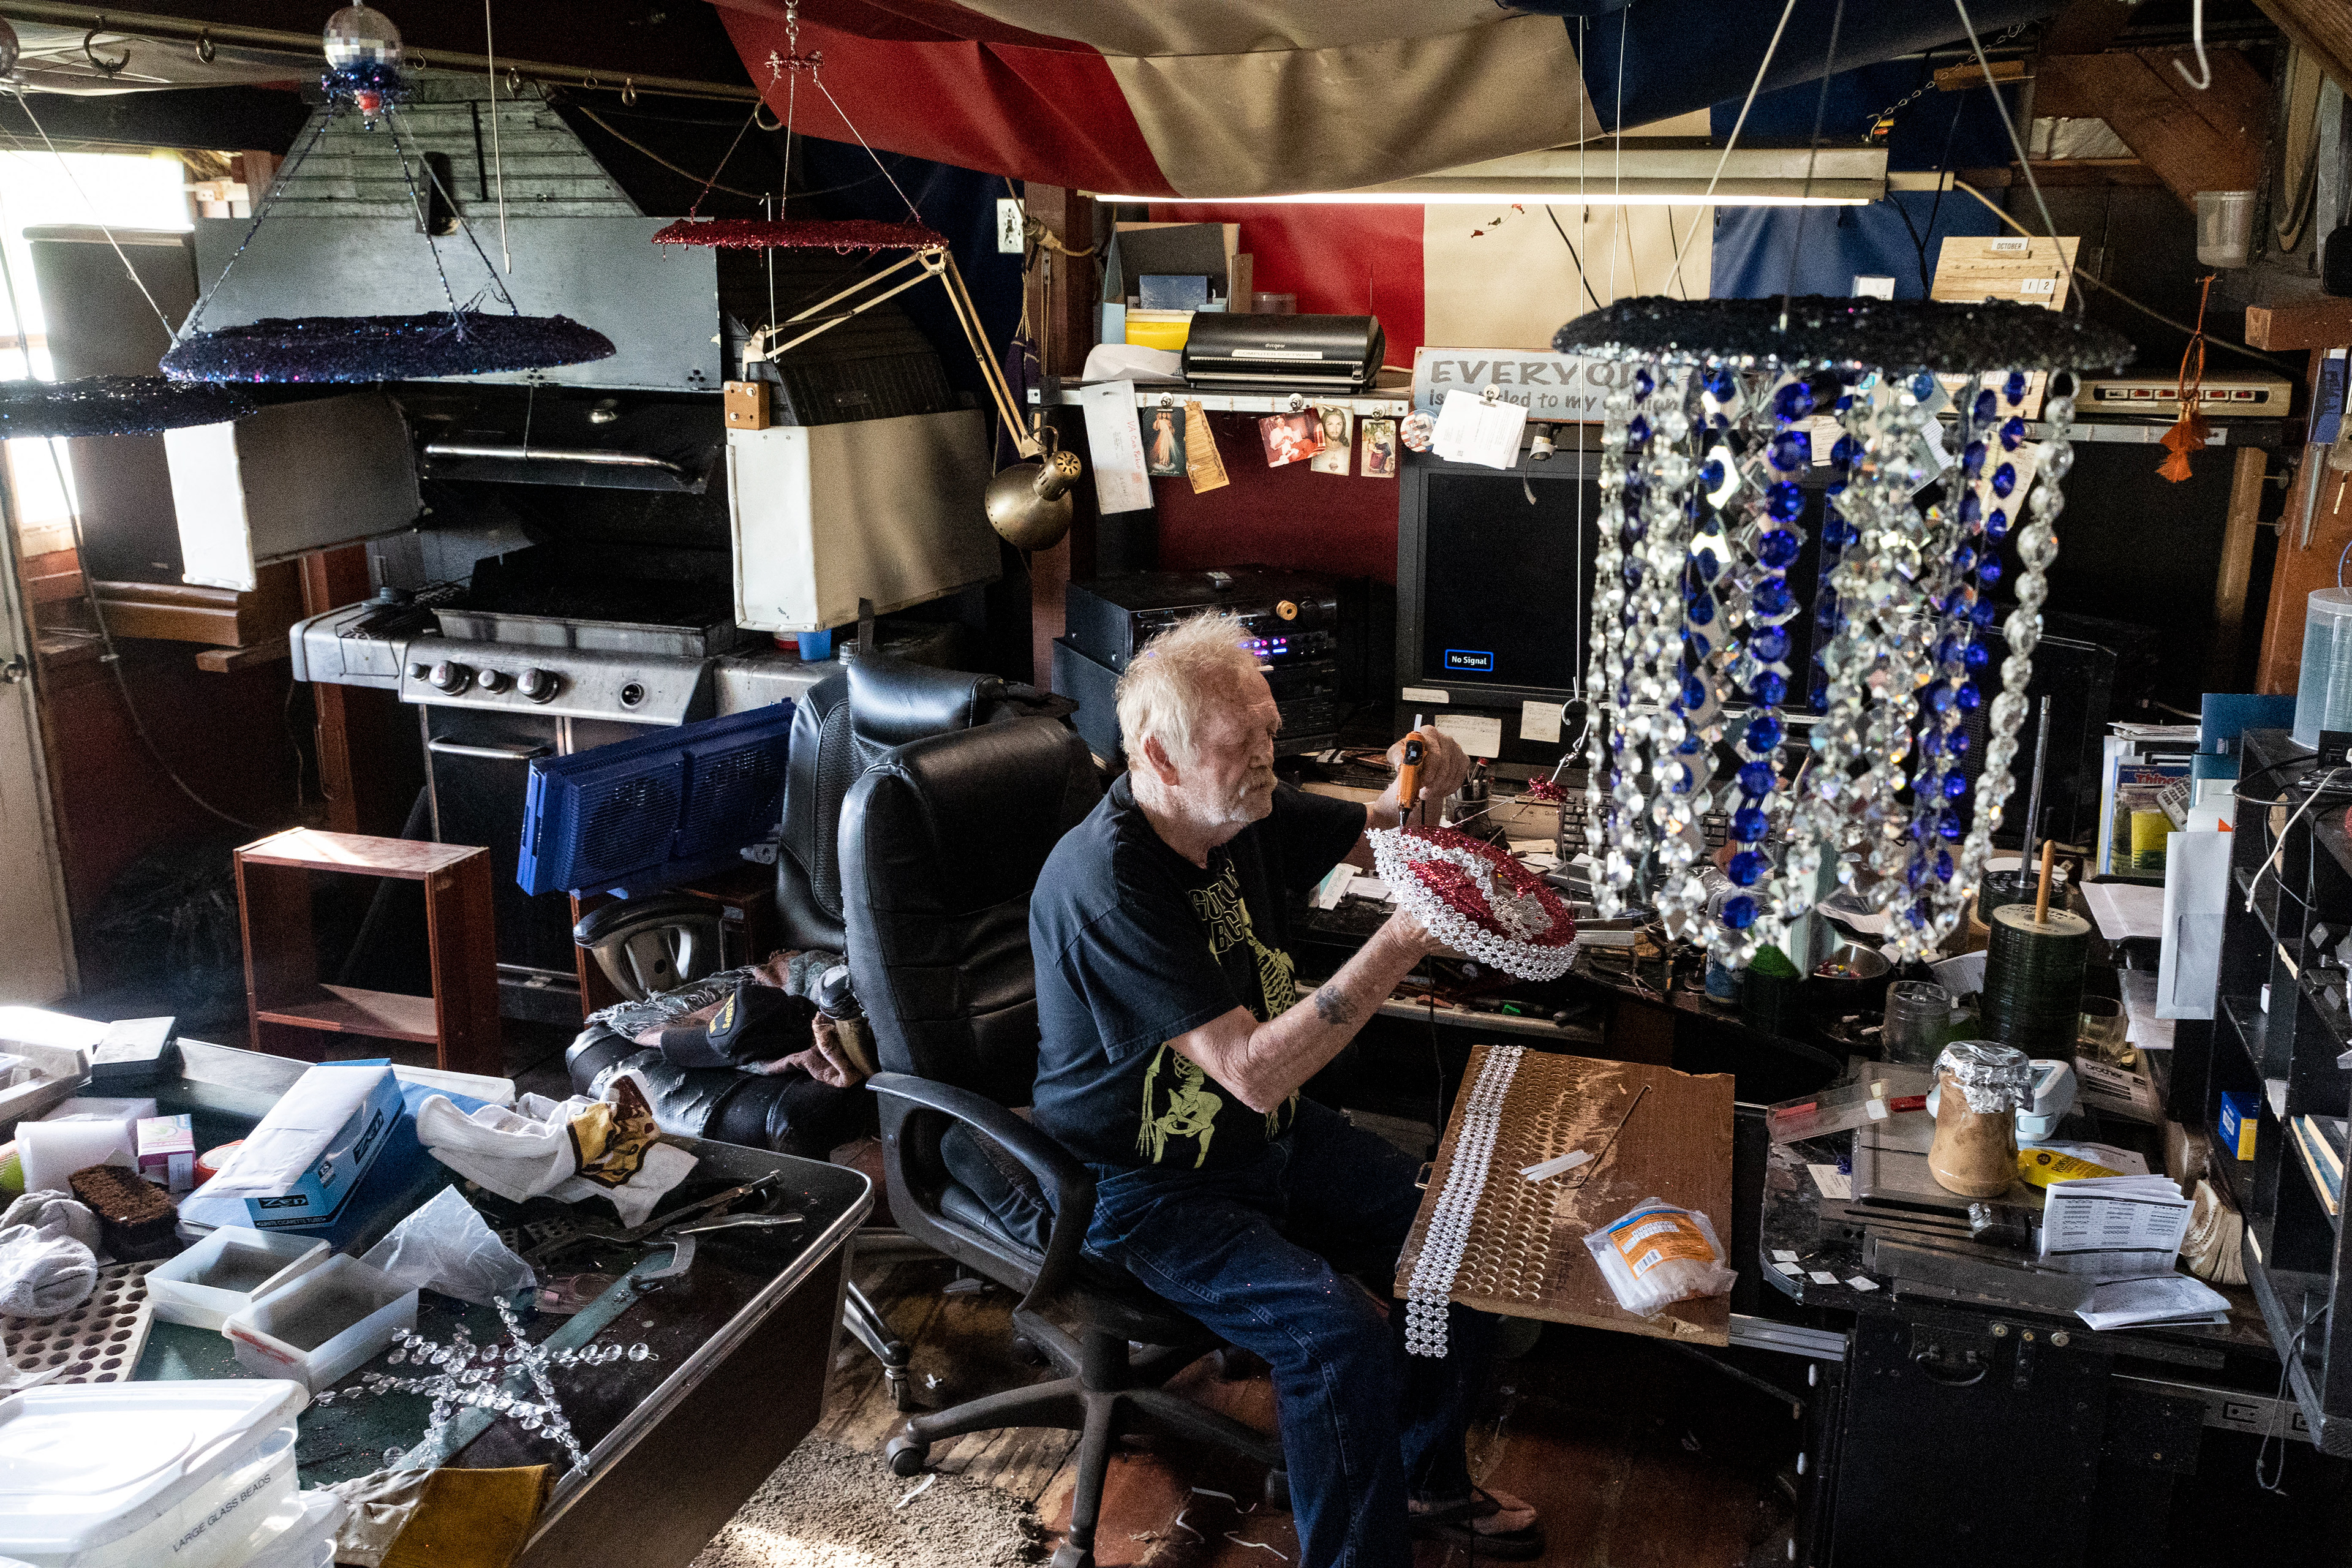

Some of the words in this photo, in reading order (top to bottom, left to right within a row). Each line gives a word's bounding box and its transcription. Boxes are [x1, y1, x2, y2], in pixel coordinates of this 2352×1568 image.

[2043, 281, 2050, 290] 2
[1537, 393, 1558, 409] to
[1565, 397, 1597, 412] my
[1463, 656, 1487, 666] Signal
[2084, 1063, 2124, 1079] brother
[172, 1522, 206, 1553] LARGE
[208, 1498, 239, 1526] GLASS
[240, 1474, 271, 1502] BEADS
